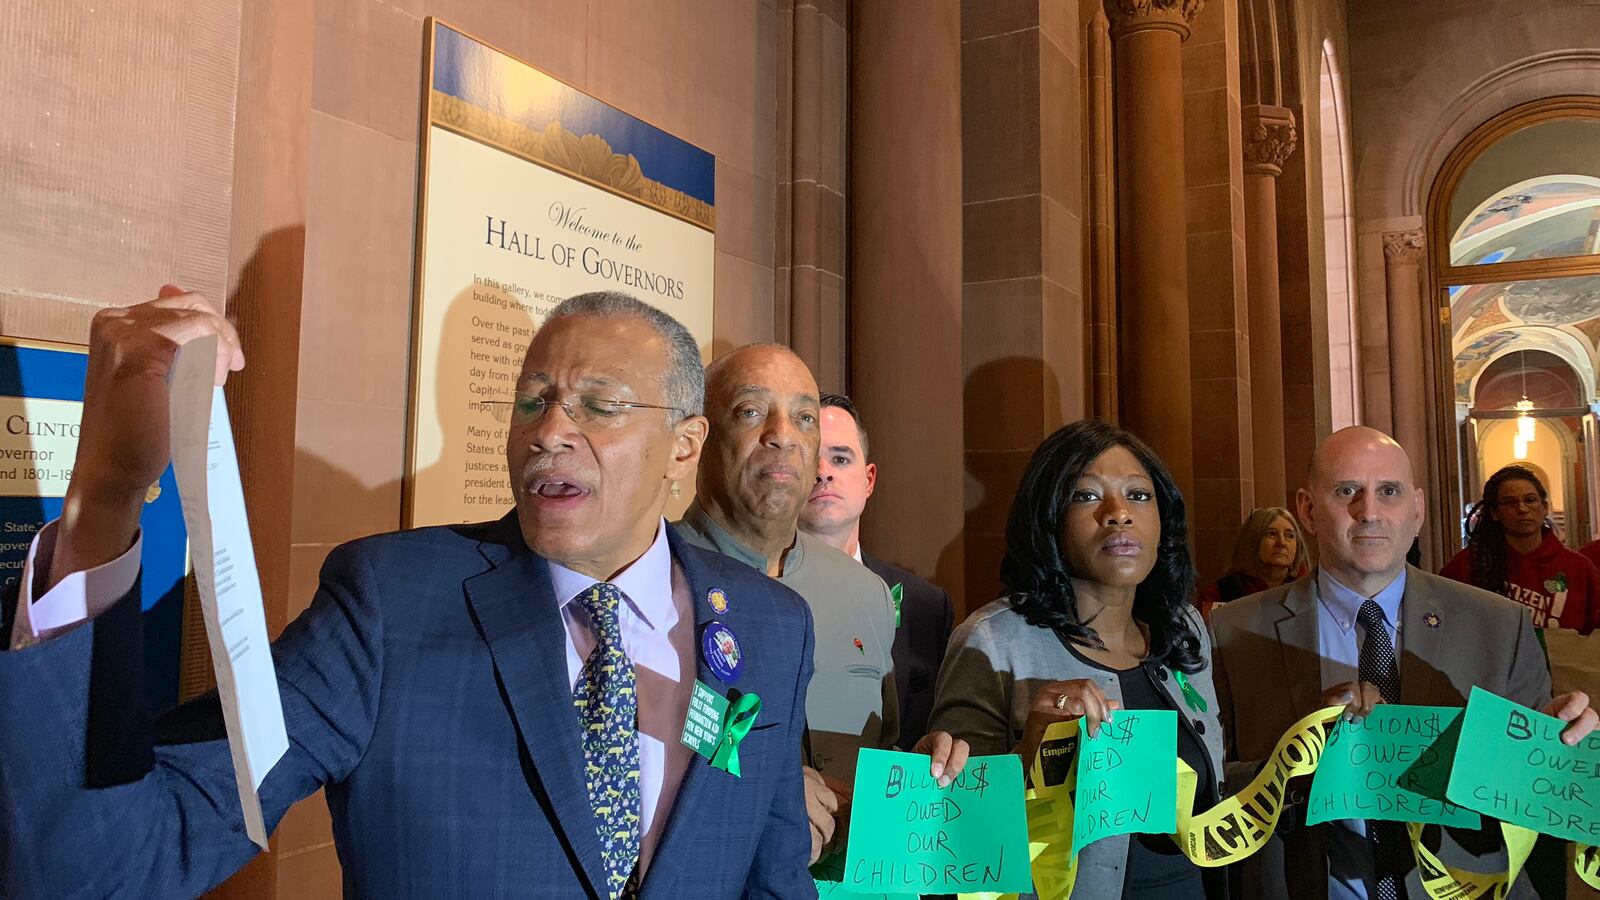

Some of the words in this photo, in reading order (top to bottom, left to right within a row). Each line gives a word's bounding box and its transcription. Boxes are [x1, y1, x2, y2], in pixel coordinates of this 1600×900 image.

[548, 201, 610, 241] Welcome
[611, 231, 623, 246] to
[625, 234, 643, 253] the
[485, 215, 545, 261] HALL
[551, 243, 576, 268] OF
[582, 246, 685, 300] GOVERNORS
[473, 273, 482, 285] In
[484, 277, 500, 289] this
[502, 283, 531, 299] gallery,
[533, 291, 545, 299] we
[546, 294, 565, 304] com
[473, 290, 507, 310] building
[509, 300, 534, 313] where
[535, 306, 549, 316] tod
[472, 316, 494, 329] Over
[496, 321, 510, 333] the
[512, 327, 530, 338] past
[471, 335, 500, 347] served
[502, 341, 512, 349] as
[470, 349, 490, 361] here
[493, 354, 510, 365] with
[470, 366, 486, 380] day
[489, 369, 509, 381] from
[467, 425, 491, 440] Many
[494, 429, 503, 439] of
[466, 442, 495, 455] States
[465, 460, 499, 472] justices
[465, 477, 505, 489] president
[464, 493, 476, 504] for
[479, 493, 493, 504] the
[1351, 743, 1439, 768] OWED
[1208, 722, 1327, 857] CAUTION
[1366, 771, 1430, 791] OUR
[1532, 777, 1593, 808] OUR
[1082, 780, 1113, 810] OUR
[1311, 793, 1457, 817] CHILDREN
[906, 798, 962, 824] OWED
[1081, 792, 1152, 840] LDREN
[907, 831, 958, 860] OUR
[853, 844, 1004, 887] CHILDREN
